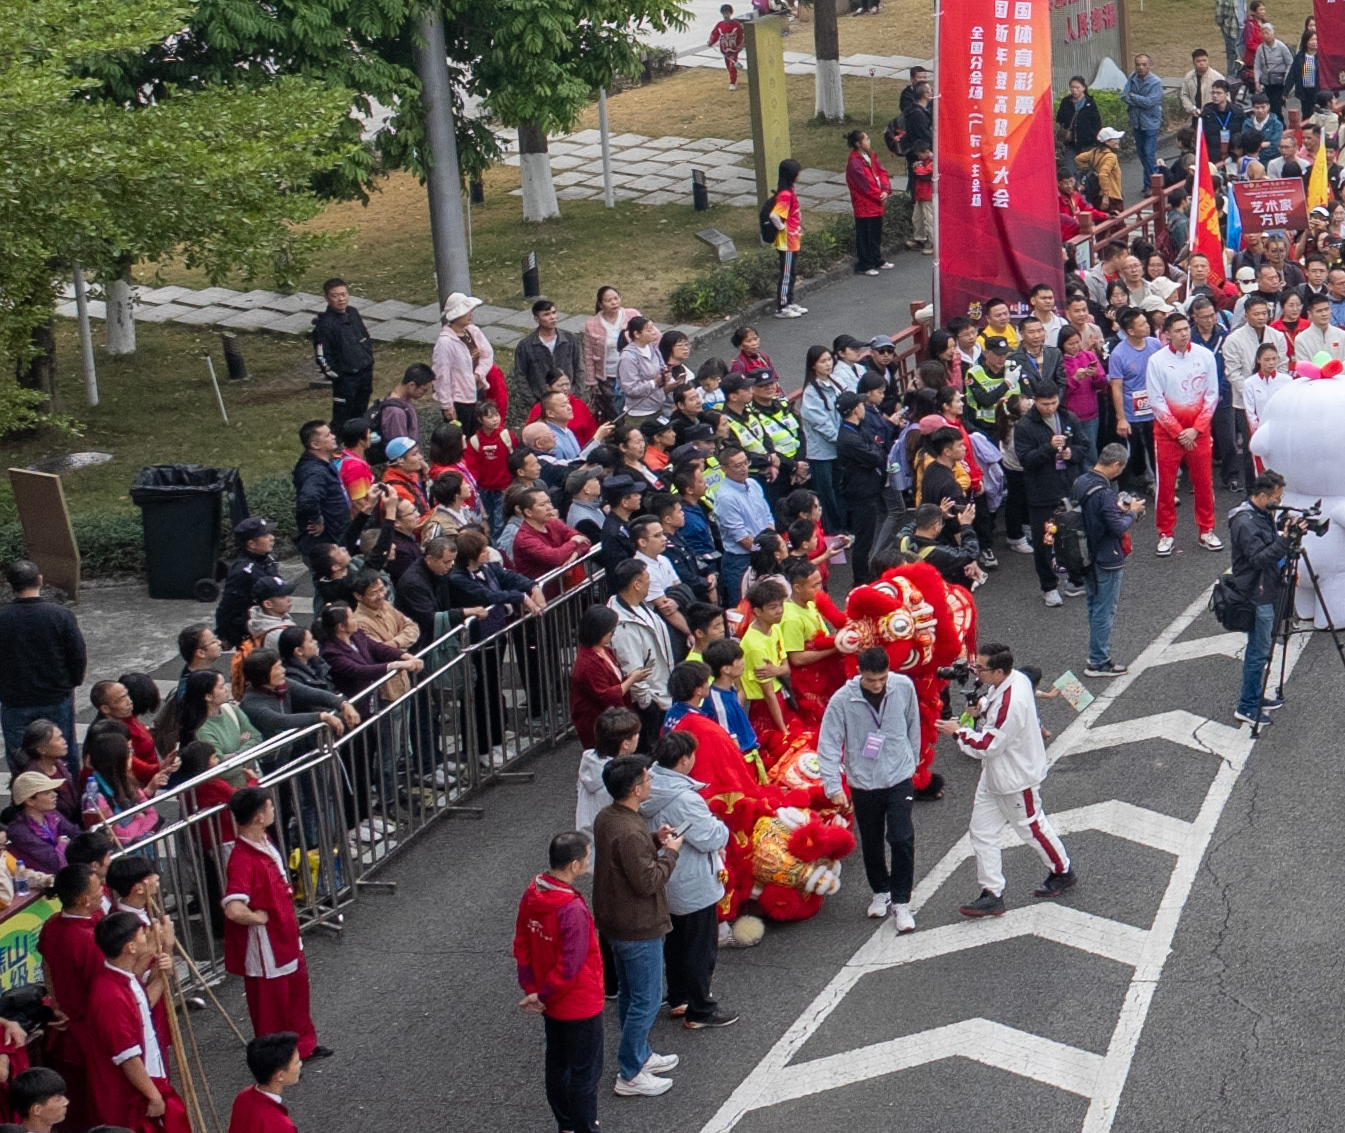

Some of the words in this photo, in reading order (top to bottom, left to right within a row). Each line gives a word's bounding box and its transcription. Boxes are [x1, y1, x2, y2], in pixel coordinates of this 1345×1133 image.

[1250, 198, 1293, 214] 艺术家
[1259, 212, 1288, 226] 方阵
